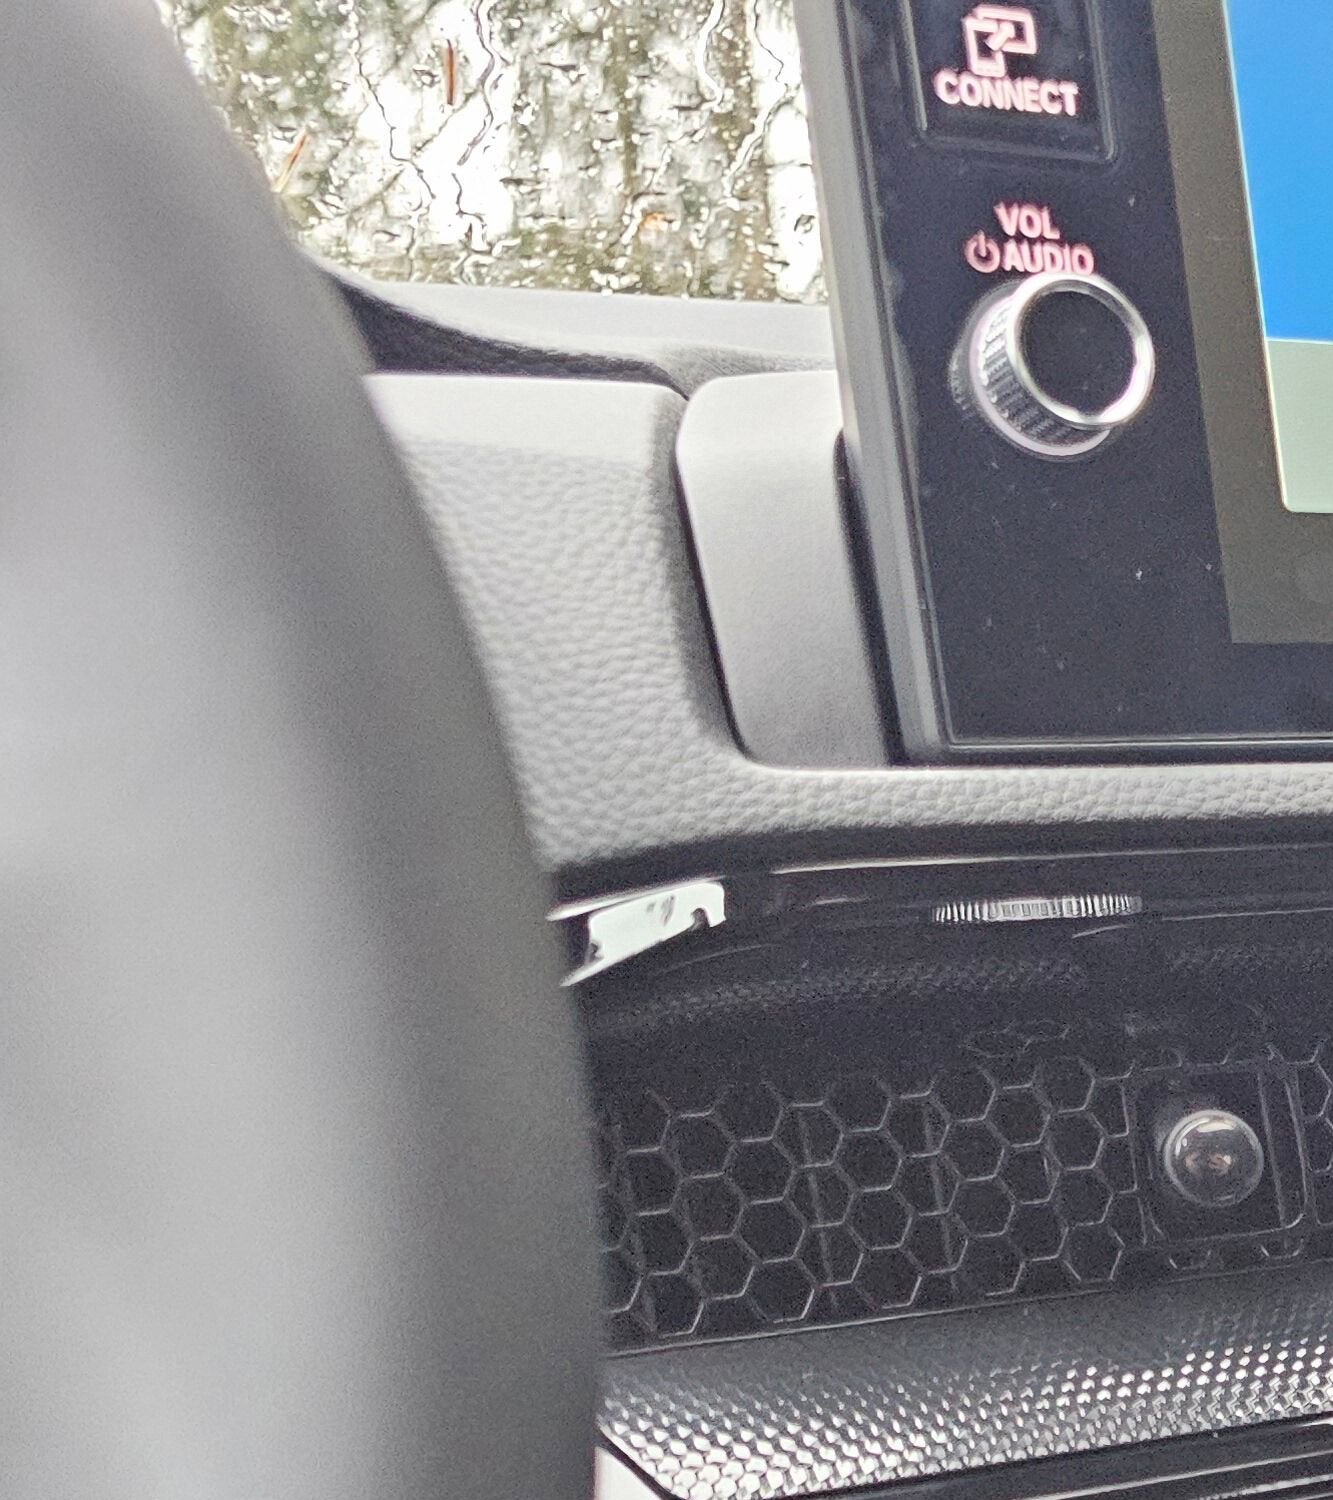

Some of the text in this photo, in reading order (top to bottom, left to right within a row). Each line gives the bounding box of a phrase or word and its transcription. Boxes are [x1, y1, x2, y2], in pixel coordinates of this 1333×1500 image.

[933, 70, 1078, 116] CONNECT
[994, 205, 1060, 240] VOL
[1002, 241, 1095, 275] AUDIO
